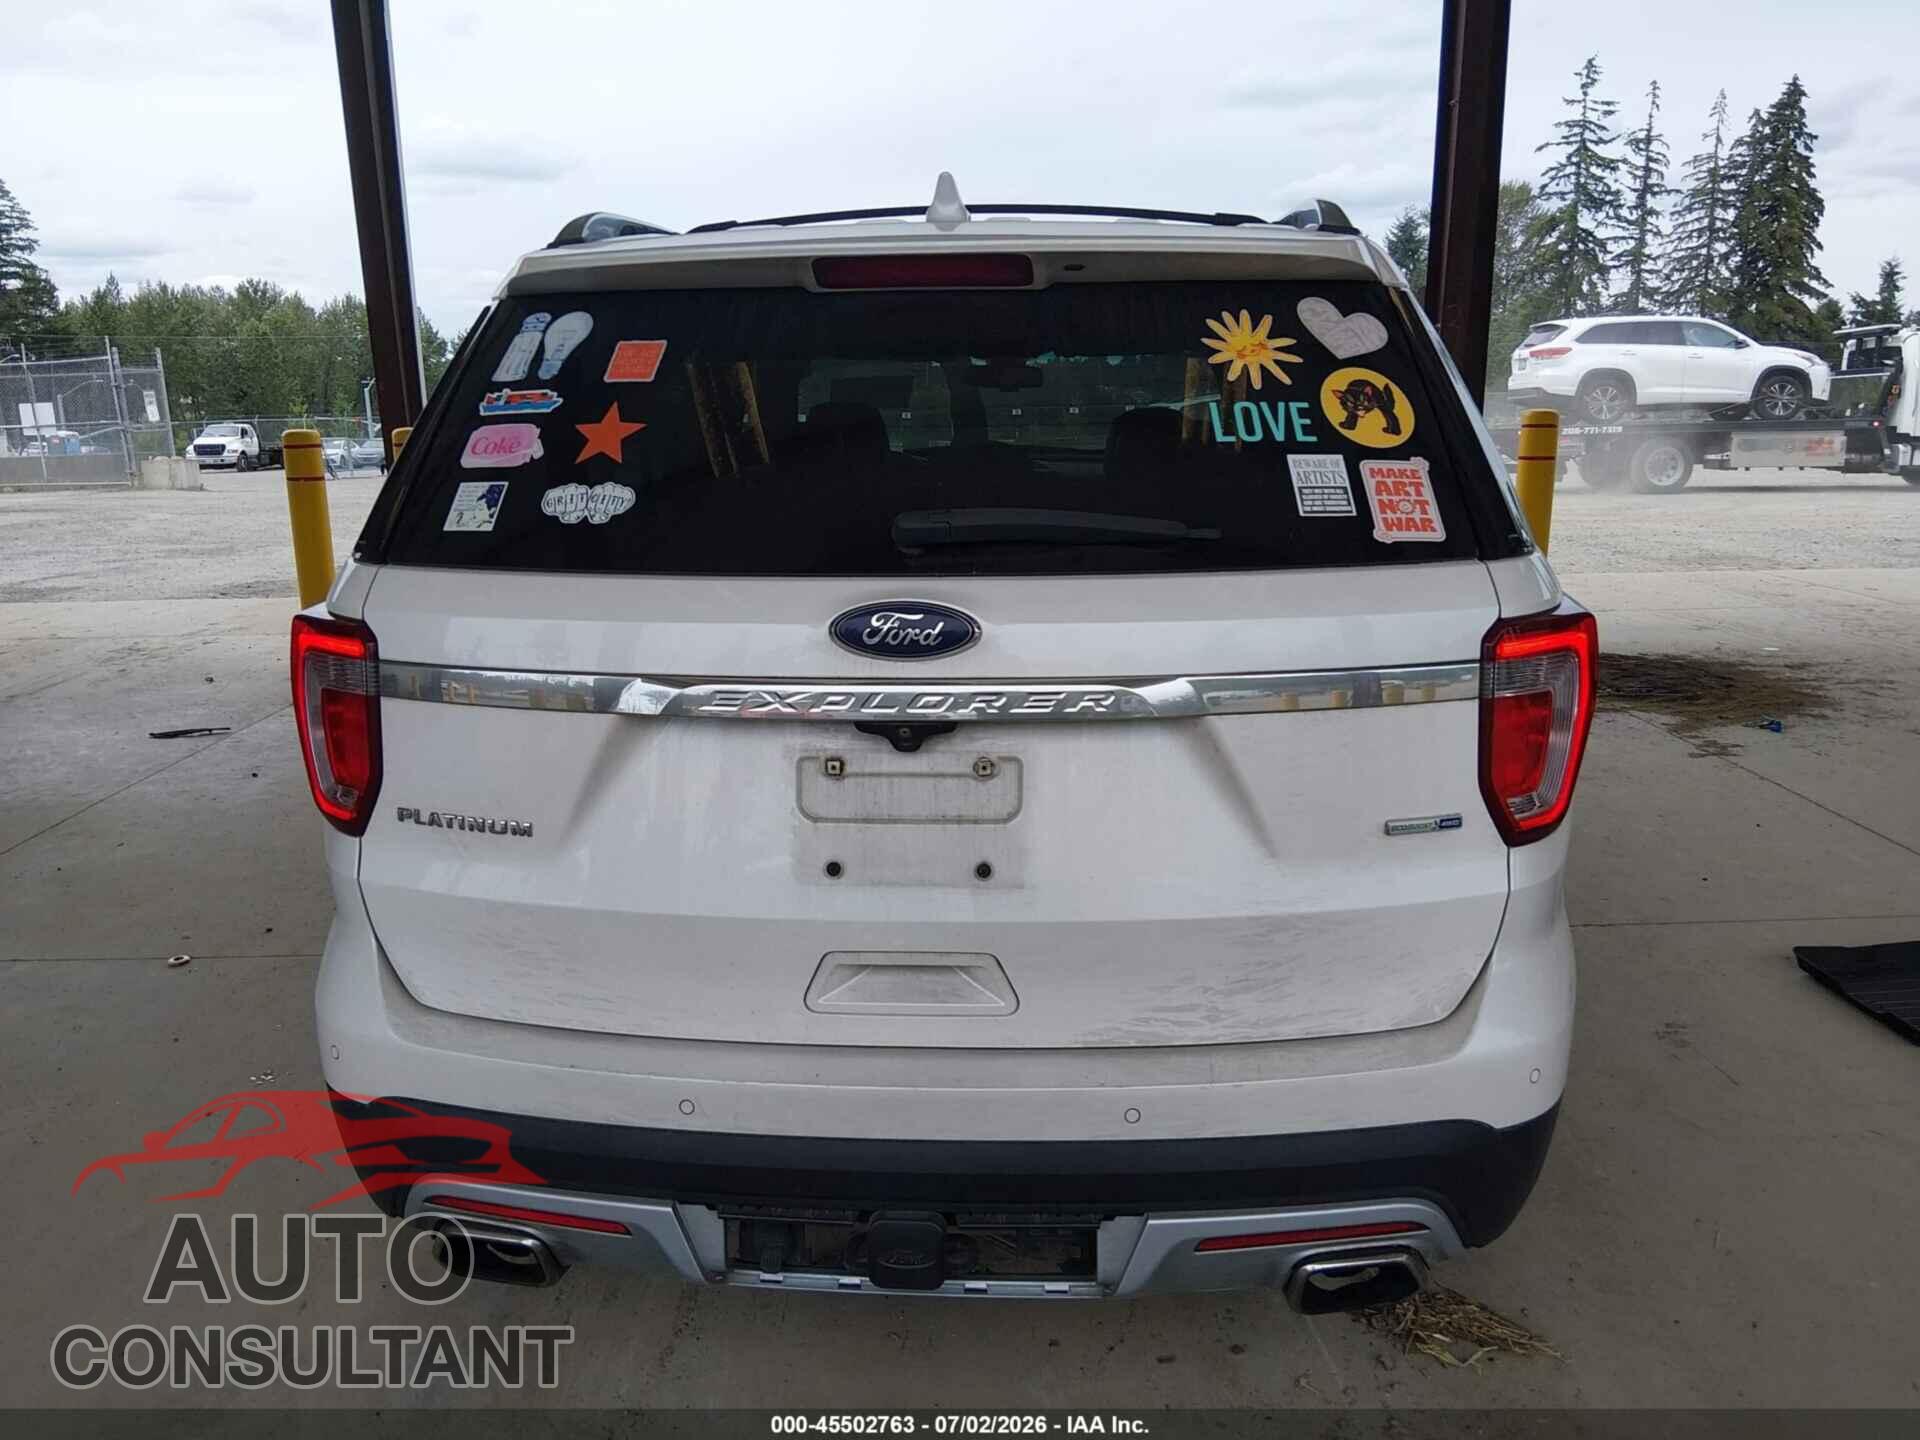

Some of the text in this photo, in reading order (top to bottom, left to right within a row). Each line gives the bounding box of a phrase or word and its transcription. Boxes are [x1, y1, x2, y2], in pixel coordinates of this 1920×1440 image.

[1208, 401, 1318, 443] LOVE
[1296, 470, 1346, 485] ARTISTS
[1369, 467, 1422, 480] MAKE
[1375, 480, 1424, 497] ART
[1378, 499, 1430, 515] NOT
[1381, 516, 1437, 532] WAR
[862, 611, 944, 647] Ford
[698, 690, 1117, 714] EXPLORER
[397, 807, 533, 837] PLATINUM
